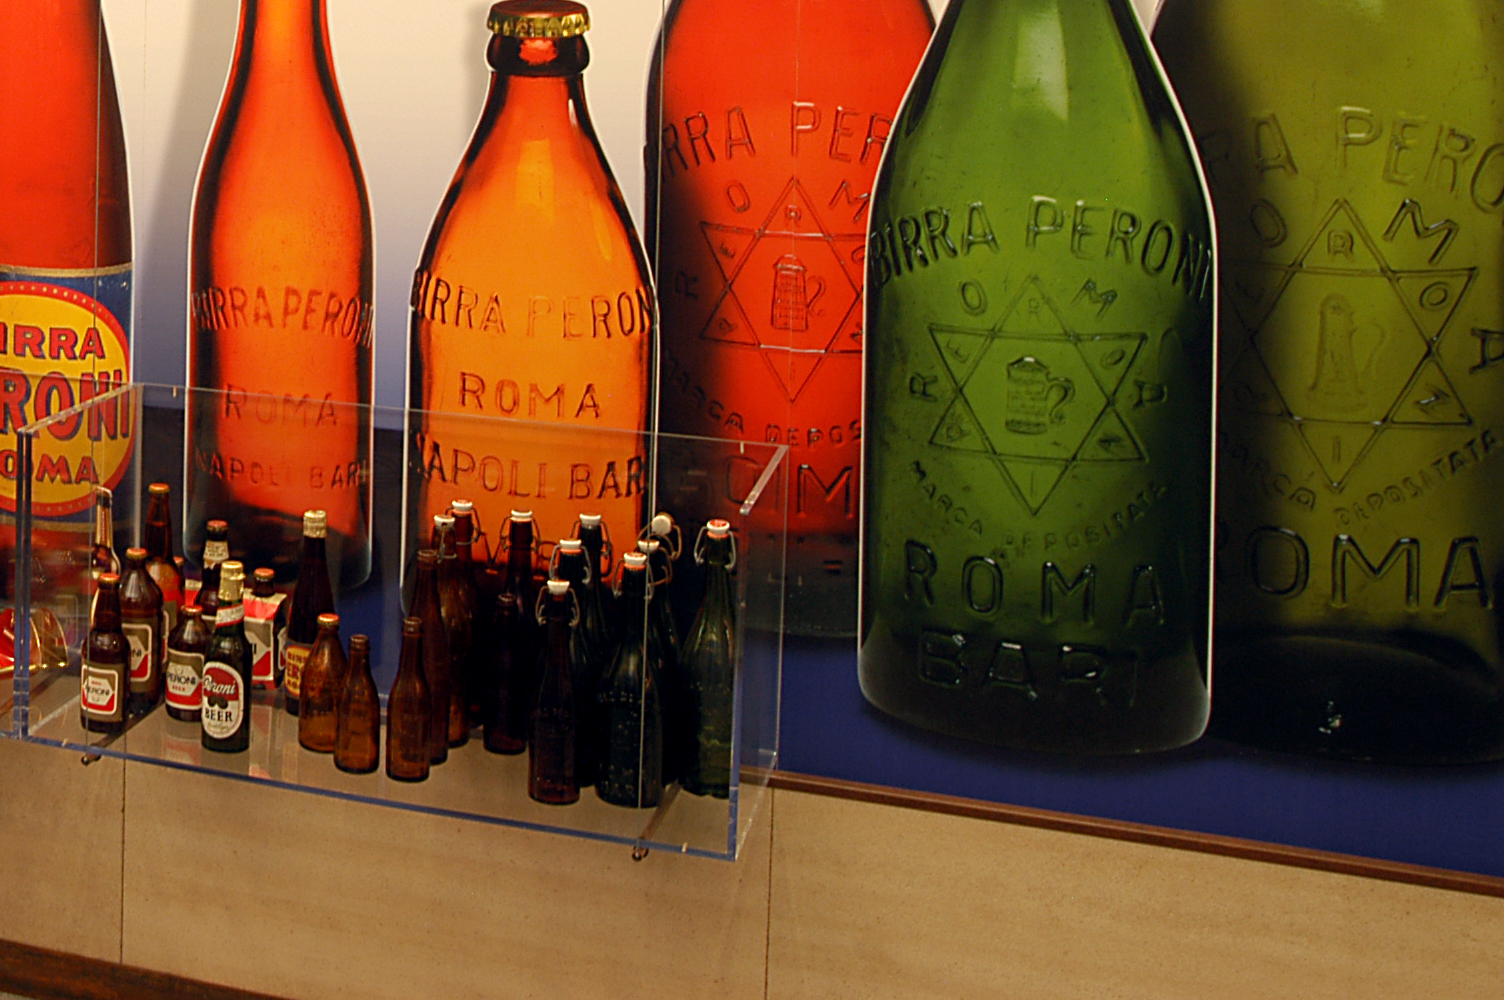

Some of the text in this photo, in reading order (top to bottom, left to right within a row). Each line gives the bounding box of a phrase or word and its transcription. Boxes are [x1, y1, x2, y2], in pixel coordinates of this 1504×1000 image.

[869, 195, 1212, 300] BIRRA PERONI
[527, 285, 656, 341] PERON
[224, 384, 337, 426] ROMA
[458, 372, 601, 419] ROMA
[568, 455, 645, 500] BAR
[904, 538, 1166, 627] ROMA
[205, 707, 234, 723] BEER
